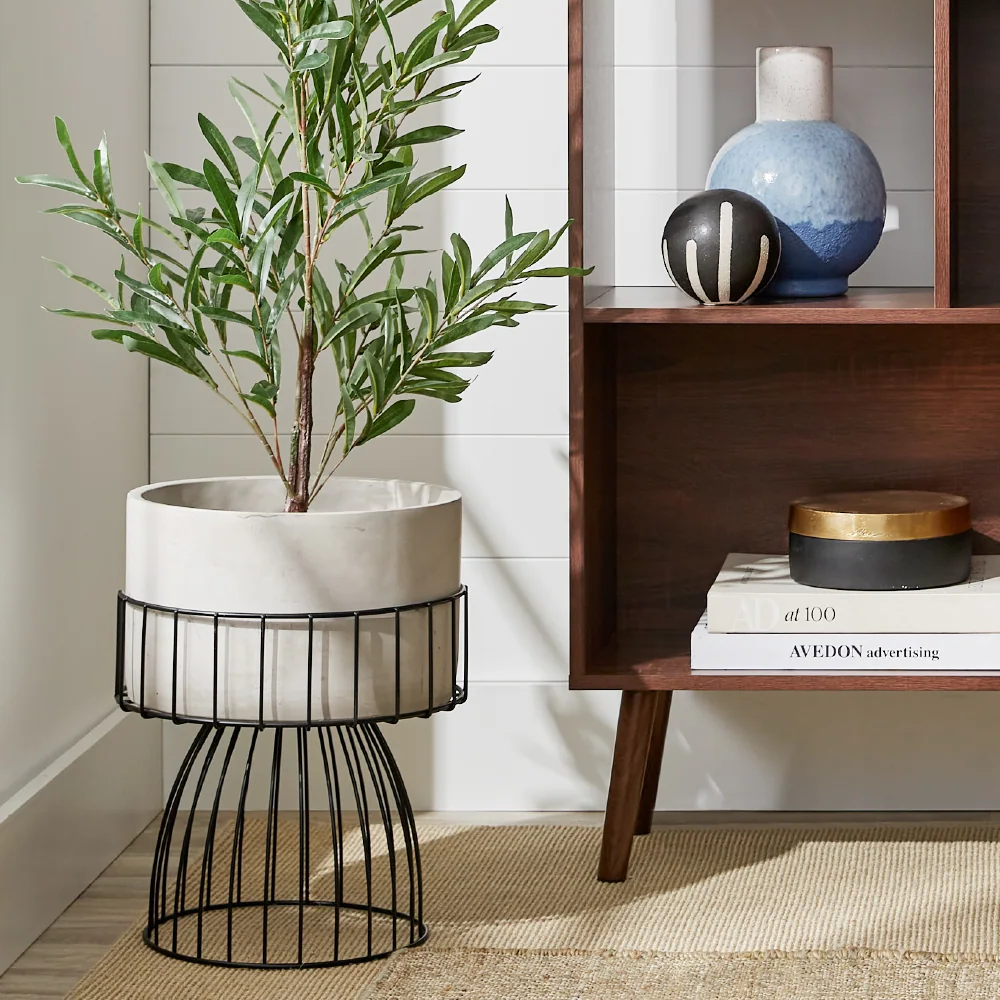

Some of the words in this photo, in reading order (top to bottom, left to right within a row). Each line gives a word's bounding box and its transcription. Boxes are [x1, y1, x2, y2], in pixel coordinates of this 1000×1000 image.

[732, 597, 780, 631] AD
[784, 607, 800, 622] at
[805, 607, 836, 622] 100
[790, 645, 863, 658] AVEDON
[866, 646, 940, 660] advertising
